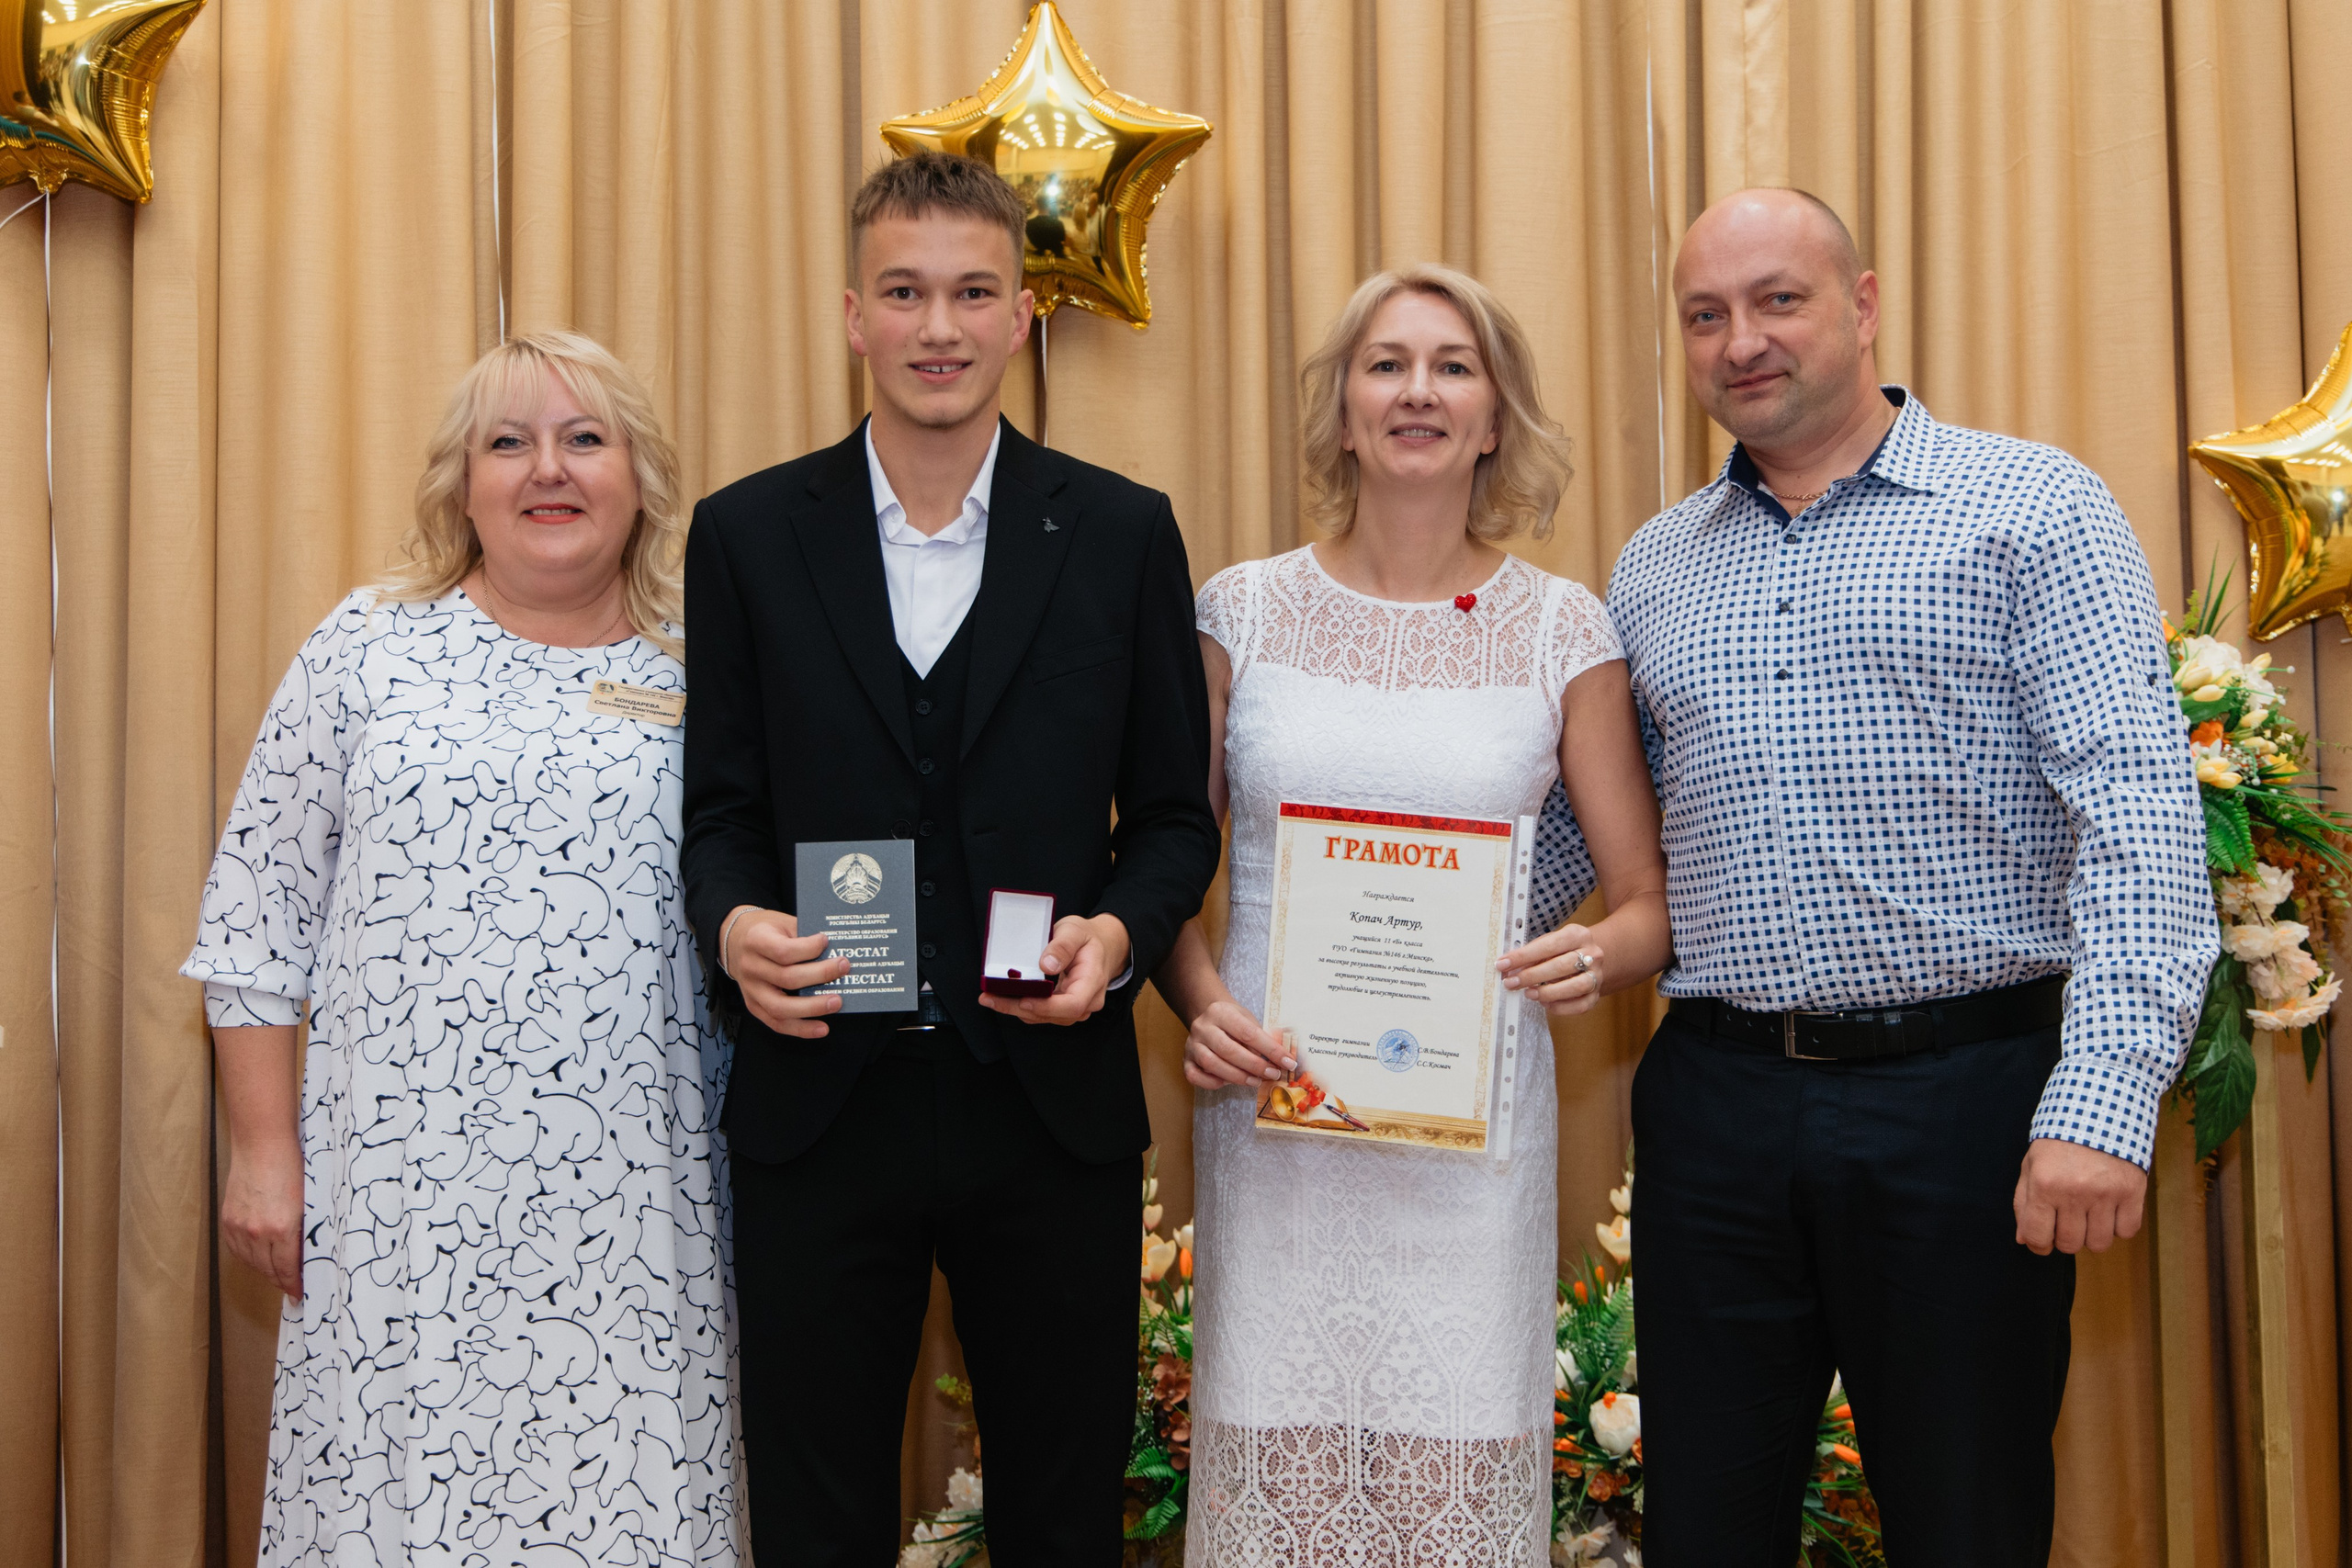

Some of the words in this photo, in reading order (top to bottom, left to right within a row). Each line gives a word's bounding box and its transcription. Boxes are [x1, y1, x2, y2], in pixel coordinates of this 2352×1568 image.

[594, 700, 630, 710] Светлана
[632, 706, 676, 718] Викторовна
[615, 697, 660, 709] БОНДАРЕВА
[1324, 834, 1460, 871] ГРАМОТА
[1362, 890, 1415, 903] Награждается
[1349, 911, 1383, 924] Копач
[1384, 915, 1423, 931] Артур,
[828, 947, 889, 959] АТЭСТАТ
[1350, 947, 1382, 955] «Гимназия
[1383, 950, 1401, 958] №146
[1326, 958, 1350, 966] высокие
[1350, 961, 1387, 969] результаты
[1392, 964, 1416, 973] учебной
[1417, 966, 1459, 978] деятельности,
[1334, 972, 1364, 981] активную
[1365, 975, 1398, 985] жизненную
[1399, 979, 1427, 988] позицию,
[1328, 984, 1363, 992] трудолюбие
[1307, 1046, 1337, 1055] Классный
[1337, 1051, 1378, 1060] руководитель
[1308, 1033, 1340, 1044] Директор
[1341, 1039, 1371, 1047] гимназии
[1417, 1047, 1460, 1058] С.В.Бондарева
